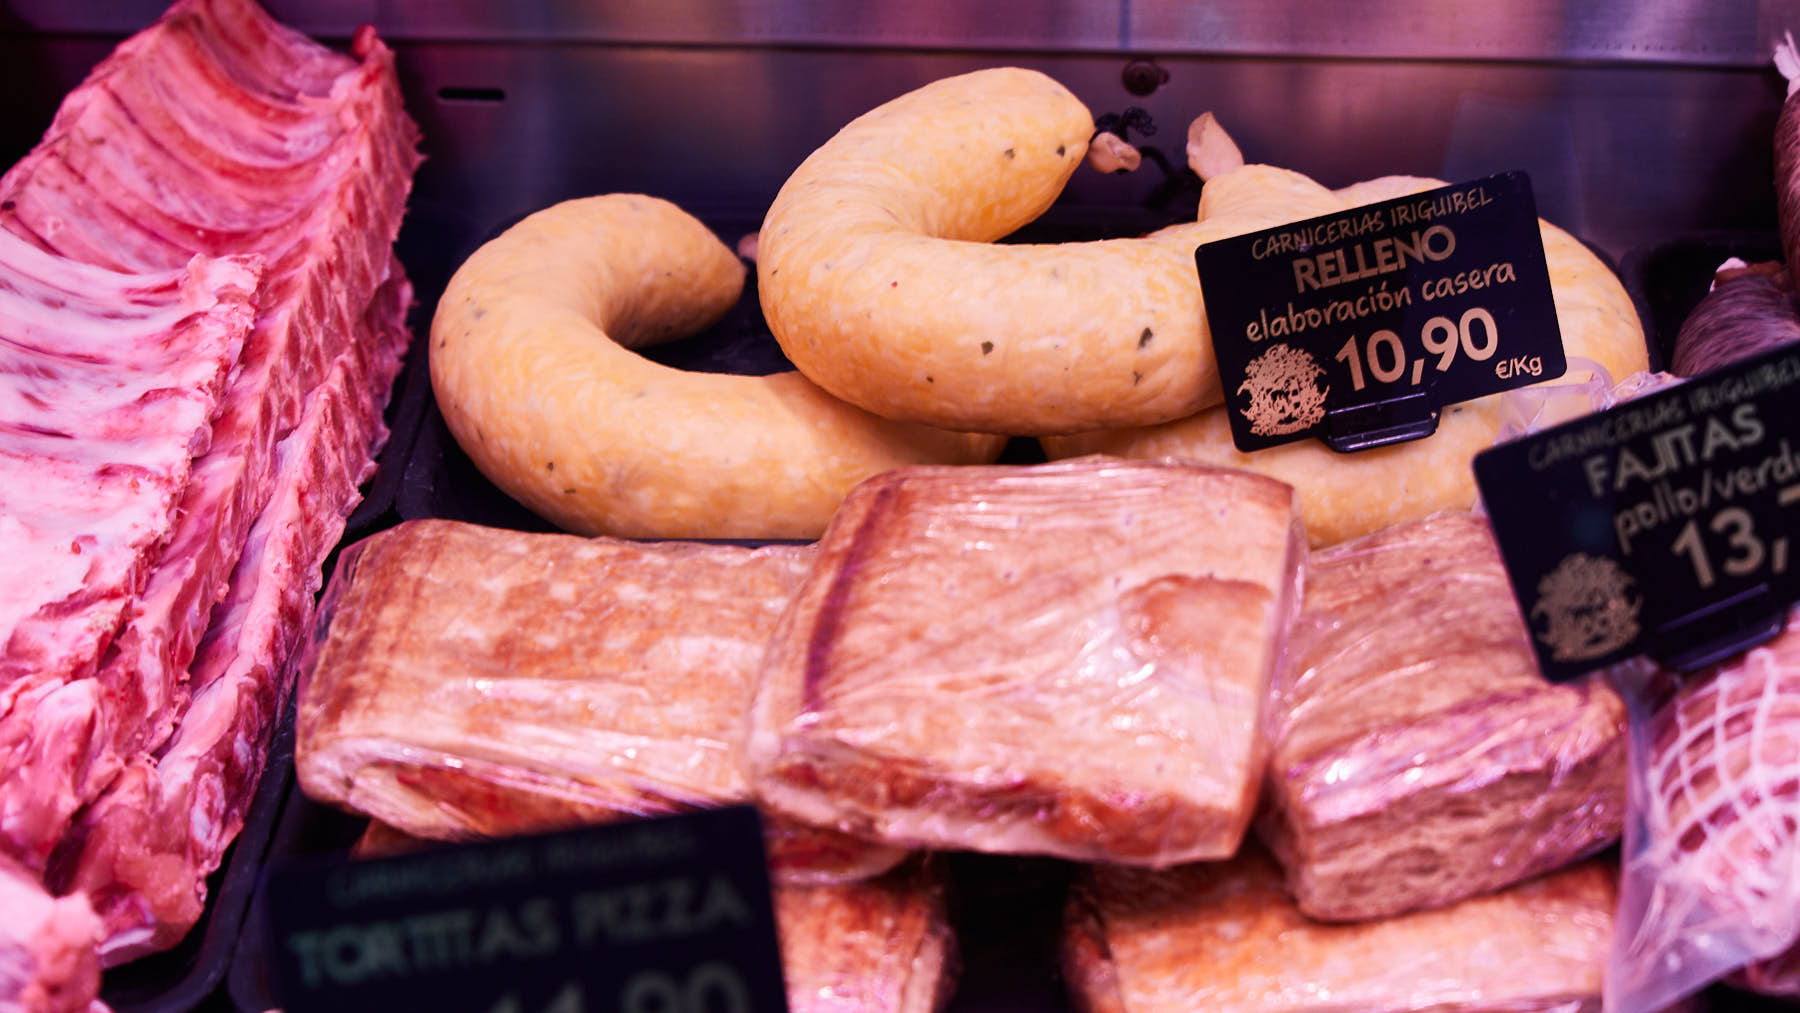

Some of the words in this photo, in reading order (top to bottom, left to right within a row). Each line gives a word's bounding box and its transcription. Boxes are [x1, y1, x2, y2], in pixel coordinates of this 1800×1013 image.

[1251, 212, 1385, 260] CARNICERIAS
[1391, 186, 1494, 227] IRIGUIBEL
[1292, 224, 1456, 294] RELLENO
[1245, 282, 1412, 344] elaboración
[1422, 261, 1517, 302] casera
[1335, 307, 1498, 392] 10,90
[1495, 355, 1543, 380] €/Kg
[1584, 404, 1764, 496] FAJITAS
[1614, 438, 1800, 556] pollo/verd
[572, 874, 754, 950] PIZZA
